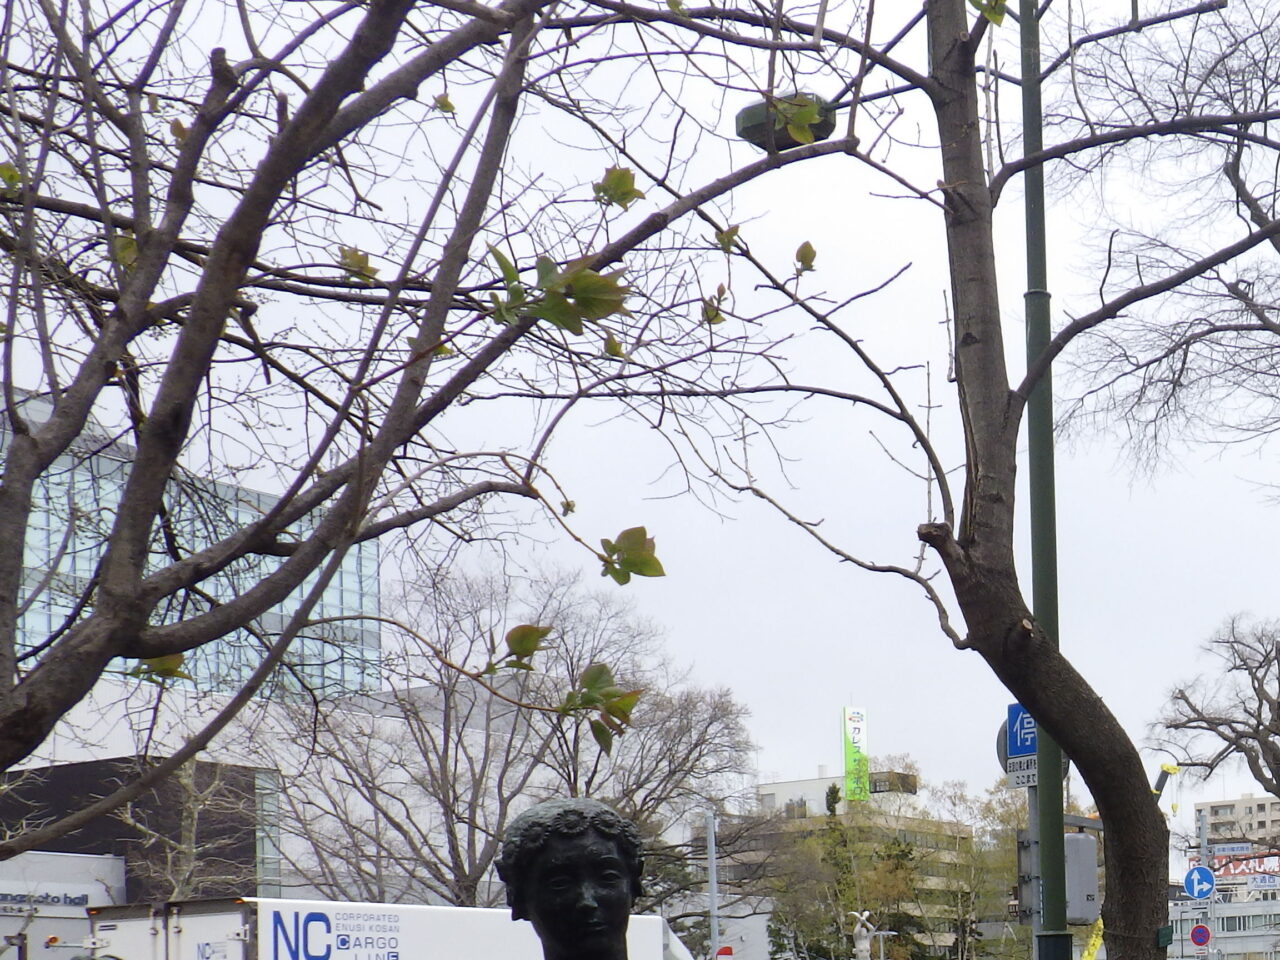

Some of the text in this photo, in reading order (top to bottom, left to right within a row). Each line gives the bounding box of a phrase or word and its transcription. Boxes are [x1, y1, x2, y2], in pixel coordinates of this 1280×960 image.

[1013, 711, 1037, 747] 停
[64, 892, 88, 905] hall
[334, 912, 400, 923] CORPORATED
[336, 934, 399, 950] CARGO
